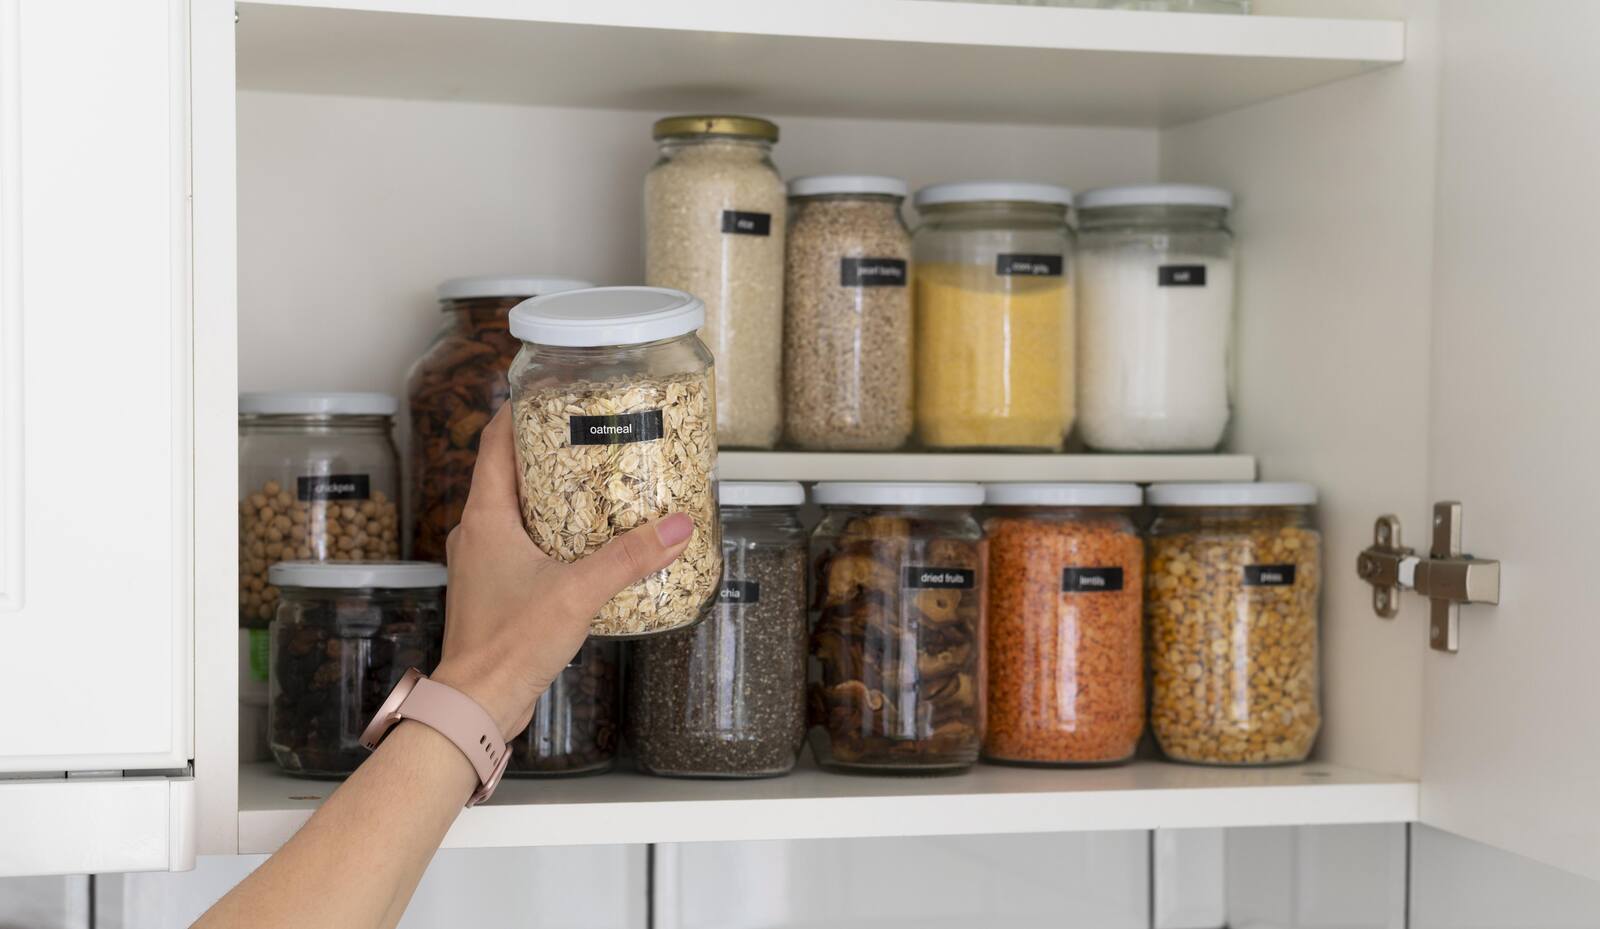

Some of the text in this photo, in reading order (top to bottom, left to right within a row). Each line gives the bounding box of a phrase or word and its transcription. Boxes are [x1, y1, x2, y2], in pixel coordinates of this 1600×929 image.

[589, 423, 632, 435] oatmeal
[920, 572, 964, 584] dried fruits
[1079, 575, 1105, 587] lentils
[720, 587, 740, 598] chia
